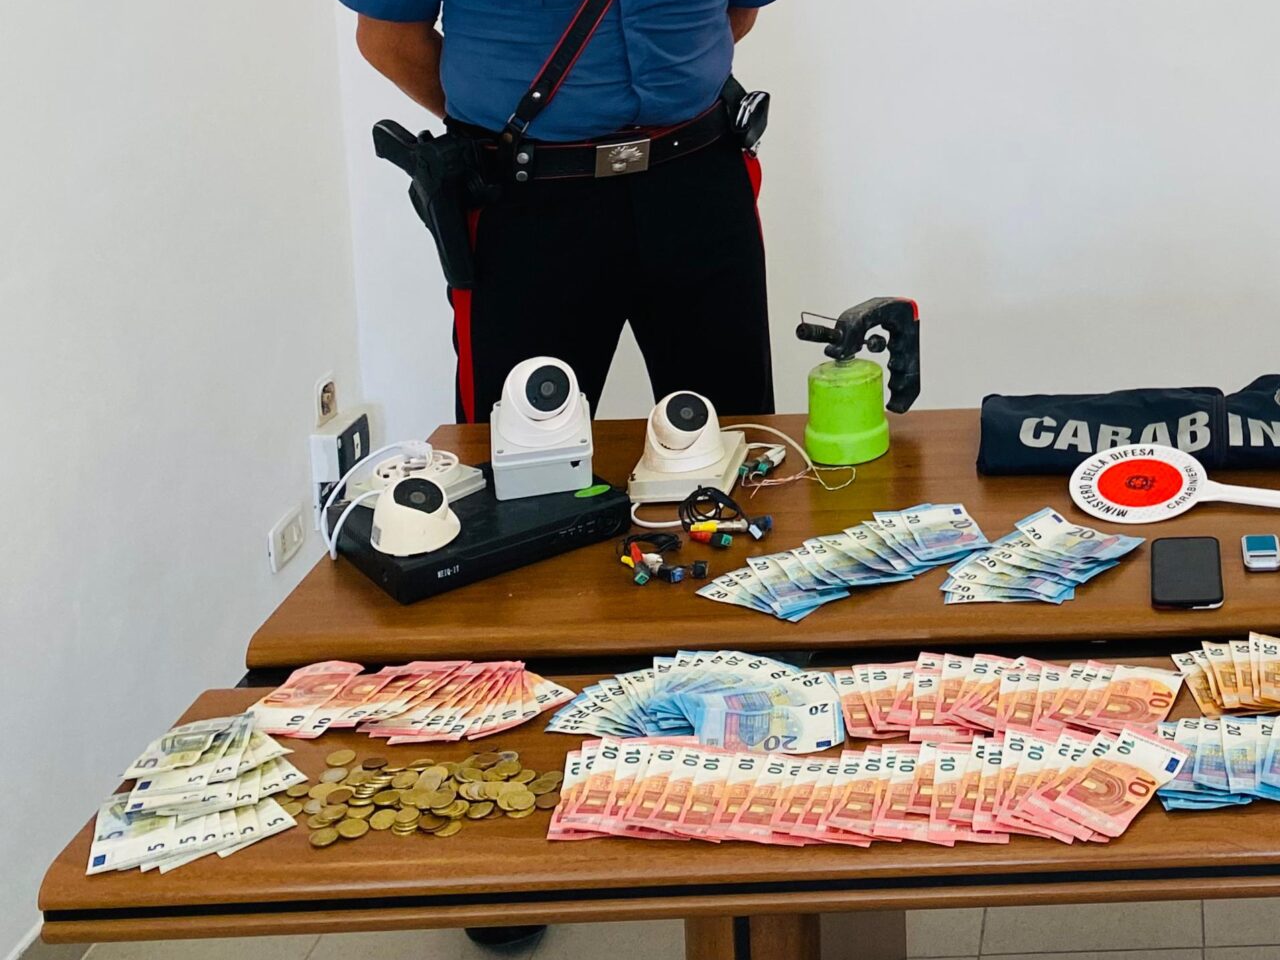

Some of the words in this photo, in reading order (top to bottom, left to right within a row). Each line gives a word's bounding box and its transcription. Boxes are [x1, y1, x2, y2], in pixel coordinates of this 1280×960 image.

[1110, 448, 1155, 461] DIFESA
[1080, 459, 1109, 481] DELLA
[1166, 465, 1198, 510] CARABINIERI
[1080, 484, 1128, 518] MINISTERO
[881, 518, 896, 528] 20
[906, 514, 920, 524] 20
[852, 530, 868, 541] 20
[1026, 527, 1042, 541] 20
[1066, 526, 1095, 540] 20
[811, 544, 827, 554] 20
[1013, 540, 1031, 548] 20
[995, 551, 1012, 560] 20
[754, 561, 769, 571] 20
[980, 556, 997, 569] 20
[959, 572, 977, 581] 20
[720, 579, 738, 588] 20
[952, 584, 971, 593] 20
[709, 590, 728, 599] 20
[1263, 643, 1278, 655] 50
[725, 656, 744, 666] 20
[748, 659, 768, 669] 20
[948, 660, 962, 670] 10
[973, 663, 989, 674] 10
[770, 670, 791, 679] 20
[872, 670, 887, 681] 10
[1007, 673, 1021, 683] 10
[1026, 673, 1041, 682] 10
[1046, 671, 1060, 682] 10
[802, 676, 824, 687] 20
[839, 676, 855, 685] 10
[918, 678, 933, 688] 10
[608, 685, 625, 697] 20
[594, 693, 611, 703] 20
[1149, 691, 1173, 708] 10
[584, 702, 603, 713] 20
[808, 703, 829, 715] 20
[348, 710, 367, 719] 10
[570, 710, 589, 719] 20
[286, 715, 304, 727] 10
[313, 717, 331, 730] 10
[1184, 720, 1200, 730] 20
[1226, 724, 1241, 736] 20
[763, 735, 798, 751] 20
[1009, 737, 1025, 751] 10
[1116, 740, 1135, 755] 10
[602, 745, 619, 760] 10
[658, 749, 675, 761] 10
[1028, 745, 1045, 761] 10
[1092, 742, 1111, 758] 10
[624, 749, 641, 764] 10
[682, 754, 700, 767] 10
[987, 750, 1003, 765] 10
[135, 758, 158, 768] 5
[703, 757, 720, 771] 10
[738, 758, 755, 770] 10
[768, 762, 784, 775] 10
[807, 763, 824, 772] 10
[843, 762, 860, 775] 10
[865, 758, 881, 771] 10
[899, 758, 916, 773] 10
[940, 756, 956, 772] 10
[282, 773, 297, 781] 5
[263, 783, 279, 791] 5
[1128, 776, 1156, 797] 10
[267, 817, 284, 827] 5
[179, 836, 197, 844] 5
[147, 843, 165, 852] 5
